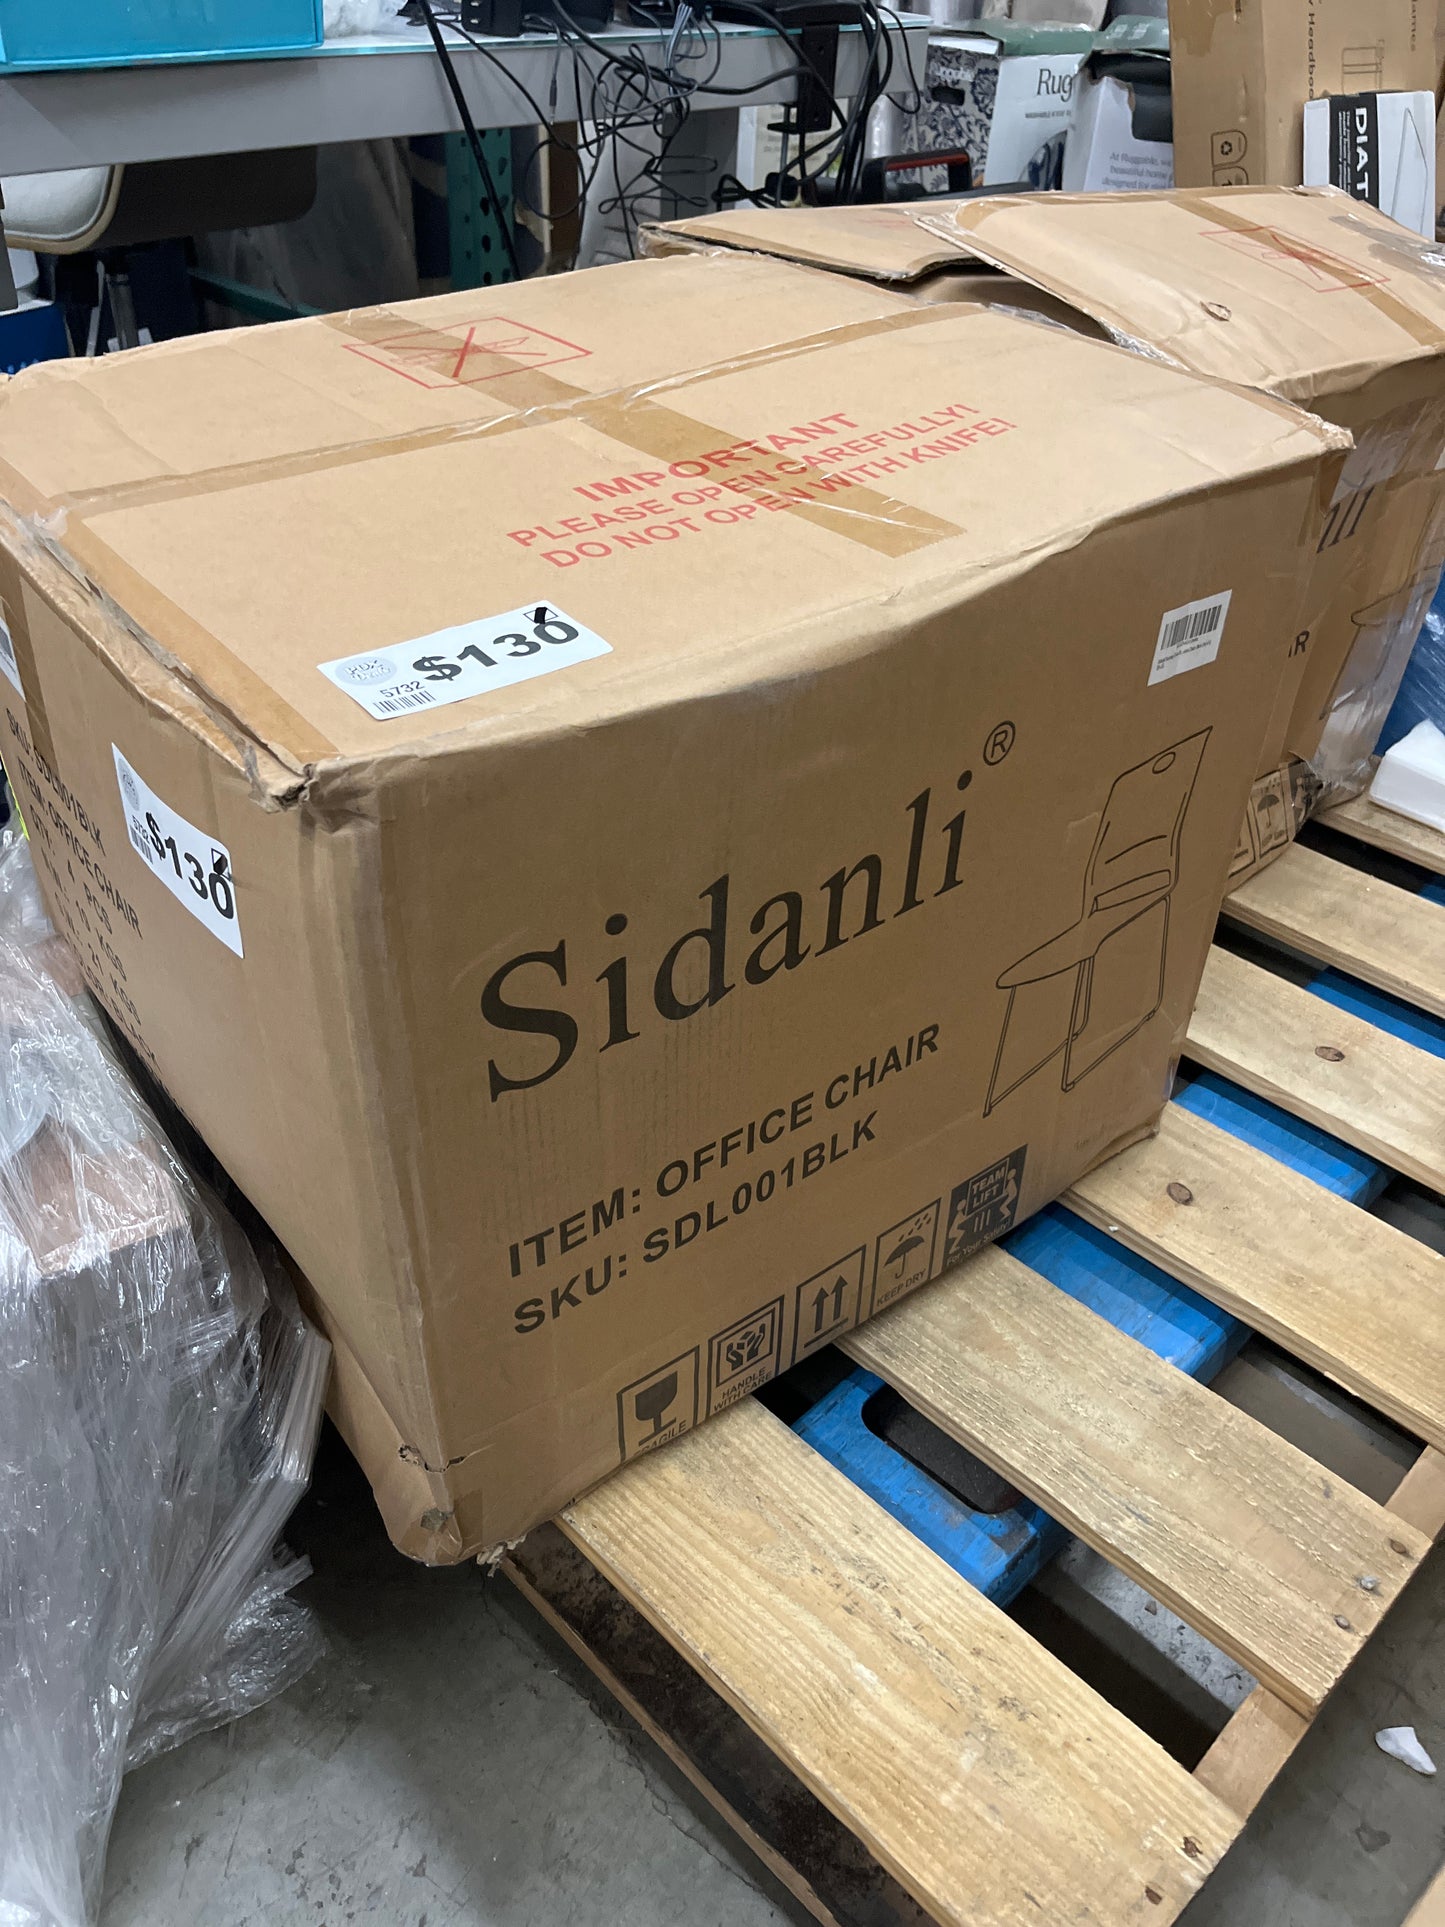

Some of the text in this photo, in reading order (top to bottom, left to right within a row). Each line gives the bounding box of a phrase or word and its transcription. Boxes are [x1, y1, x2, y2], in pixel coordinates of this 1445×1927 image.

[507, 403, 981, 547] PLEASE OPEN CAREFULLY!
[541, 417, 1018, 569] DO NOT OPEN WITH KNIFE!
[573, 412, 862, 502] IMPORTANT
[413, 620, 579, 681] $130
[380, 680, 425, 698] 5732
[47, 800, 94, 878] OFFICE
[93, 863, 143, 940] CHAIR
[145, 811, 234, 919] $130
[83, 882, 112, 935] PCS
[481, 770, 973, 1103] Sidanli
[509, 1023, 940, 1278] ITEM: OFFICE CHAIR
[972, 1166, 1005, 1193] TEAM
[514, 1110, 877, 1335] SKU: SDL001BLK
[973, 1183, 1000, 1208] LIFT
[877, 1268, 926, 1307] KEEP DRY
[713, 1371, 773, 1412] WITH CARE
[722, 1366, 766, 1400] HANDLE
